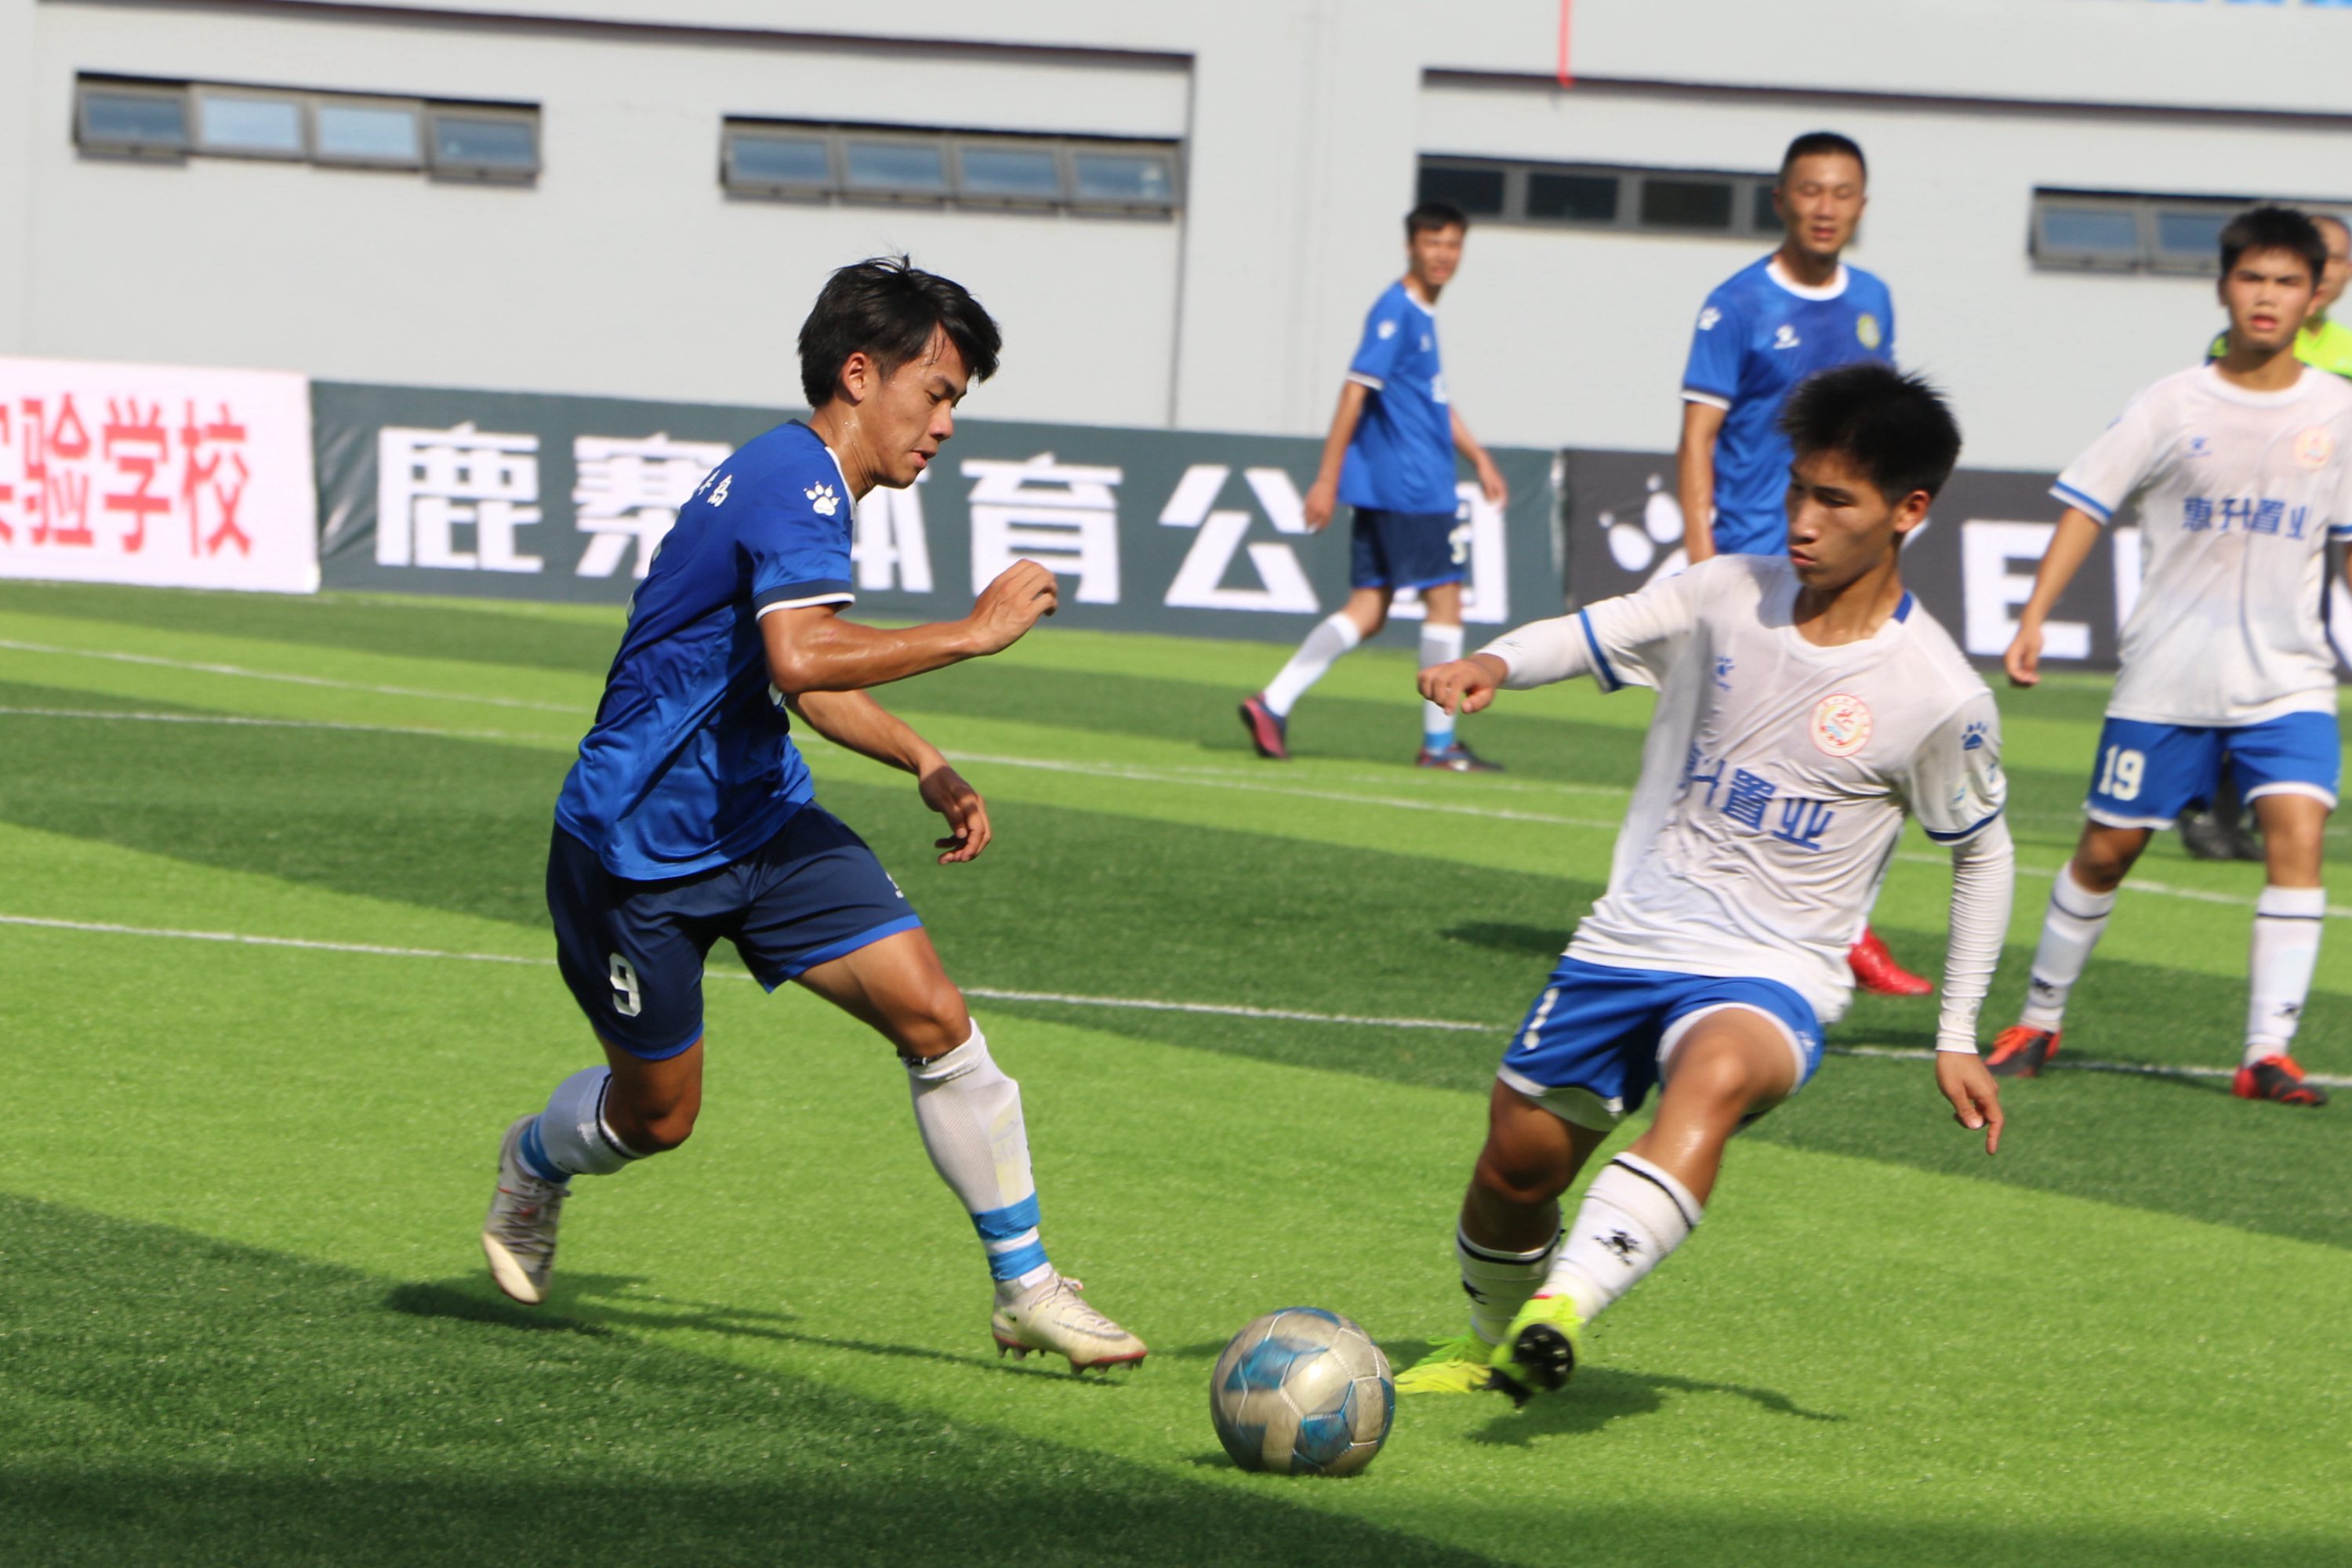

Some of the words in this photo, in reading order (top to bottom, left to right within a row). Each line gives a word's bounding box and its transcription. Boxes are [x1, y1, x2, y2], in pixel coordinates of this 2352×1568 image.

[0, 393, 251, 557] 验学校
[2098, 745, 2145, 800] 19
[609, 953, 641, 1018] 9
